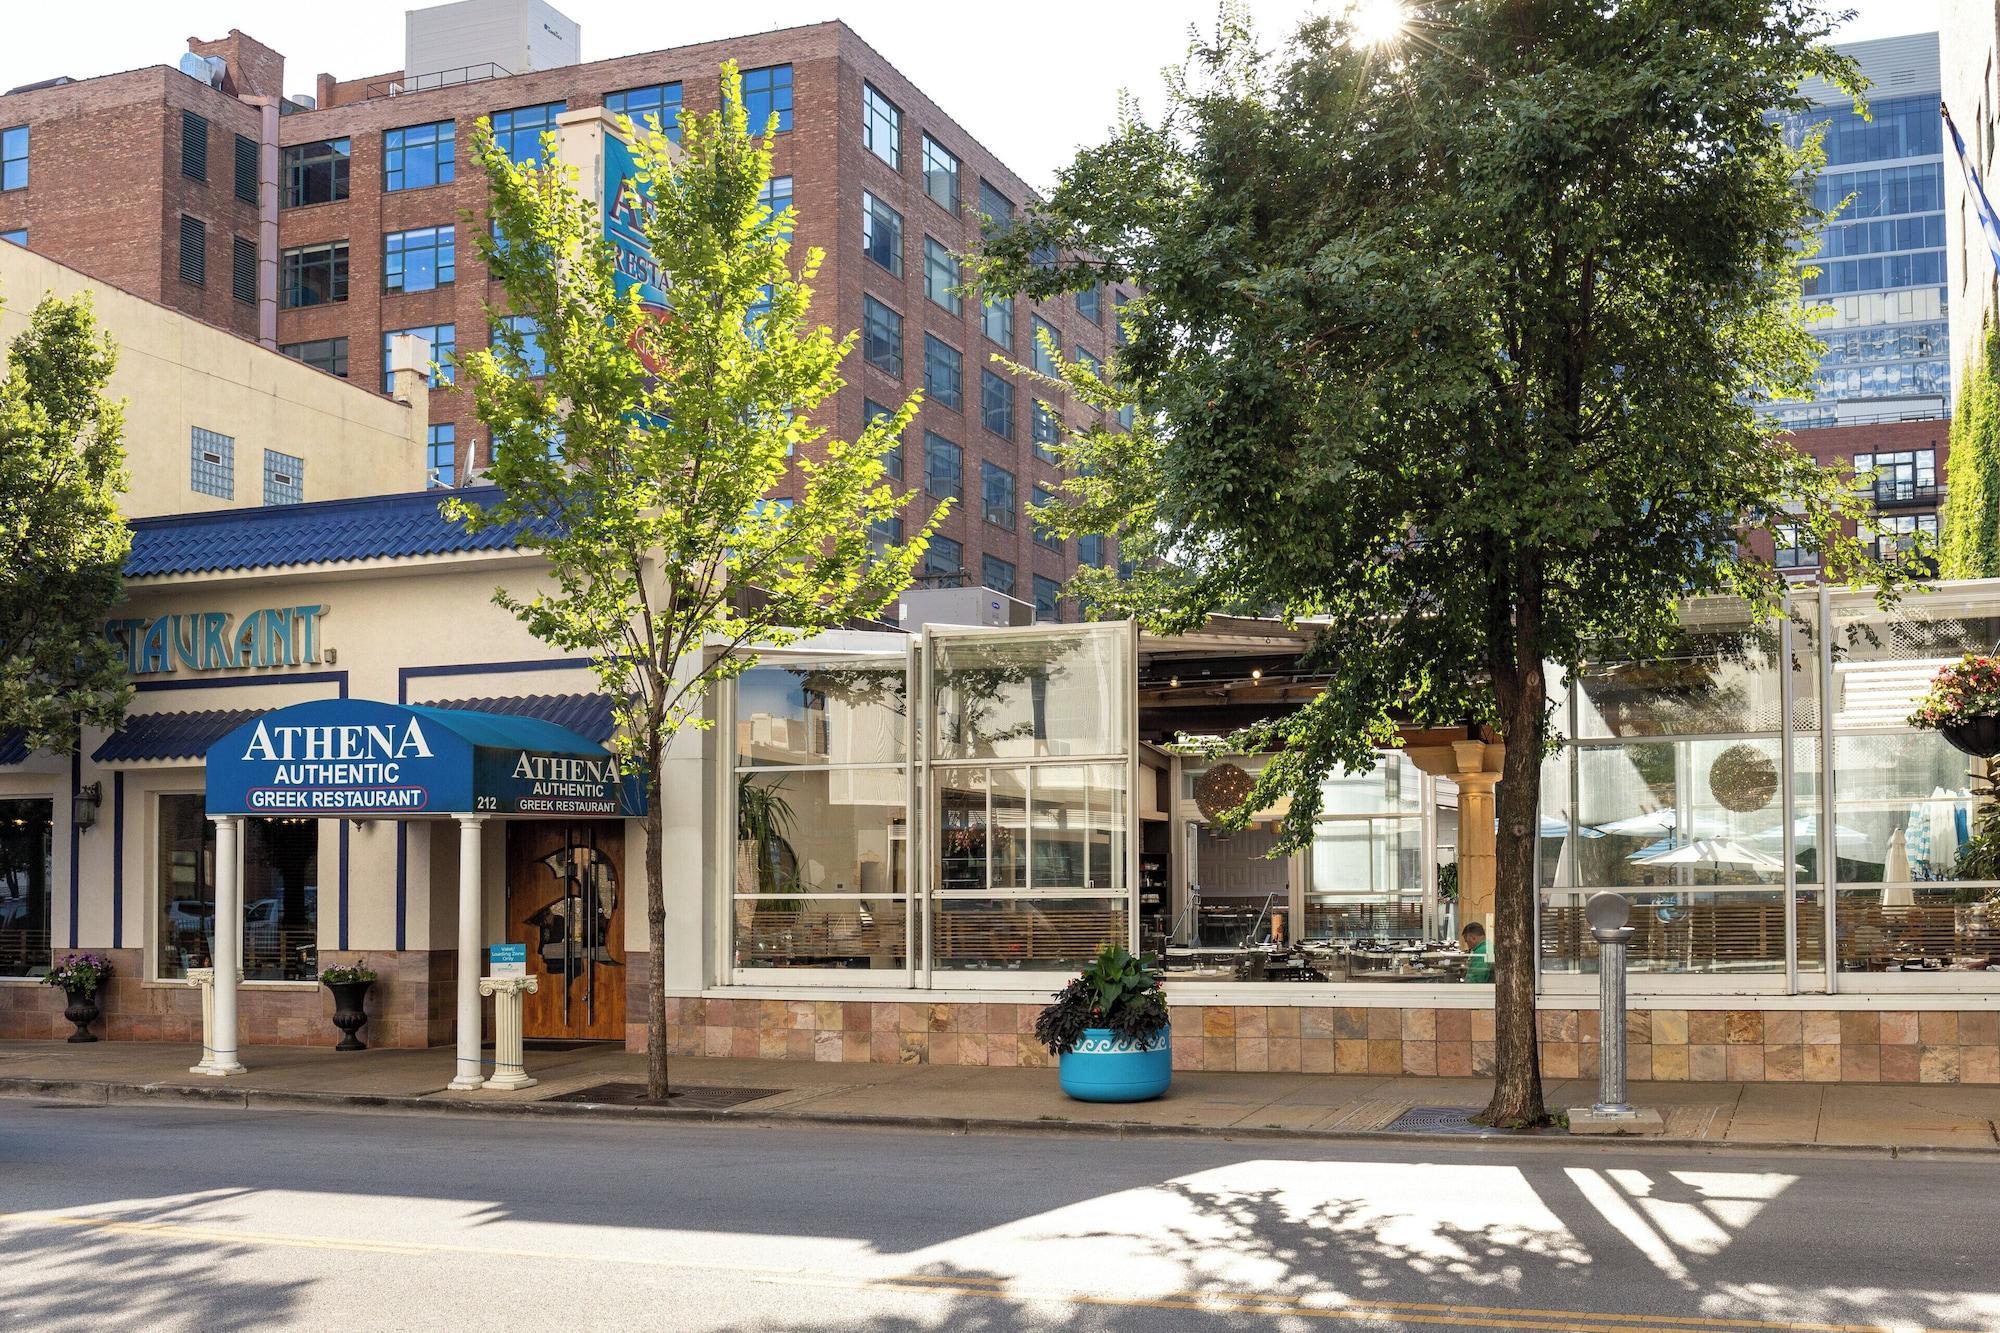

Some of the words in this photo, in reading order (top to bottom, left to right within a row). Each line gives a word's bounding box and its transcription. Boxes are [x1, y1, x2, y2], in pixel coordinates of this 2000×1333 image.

[241, 716, 434, 761] ATHENA
[274, 763, 399, 784] AUTHENTIC
[511, 751, 621, 784] ATHENA
[252, 791, 308, 807] GREEK
[312, 790, 421, 807] RESTAURANT
[533, 782, 604, 798] AUTHENTIC
[477, 796, 497, 810] 212
[520, 799, 554, 811] GREEK
[555, 801, 616, 813] RESTAURANT
